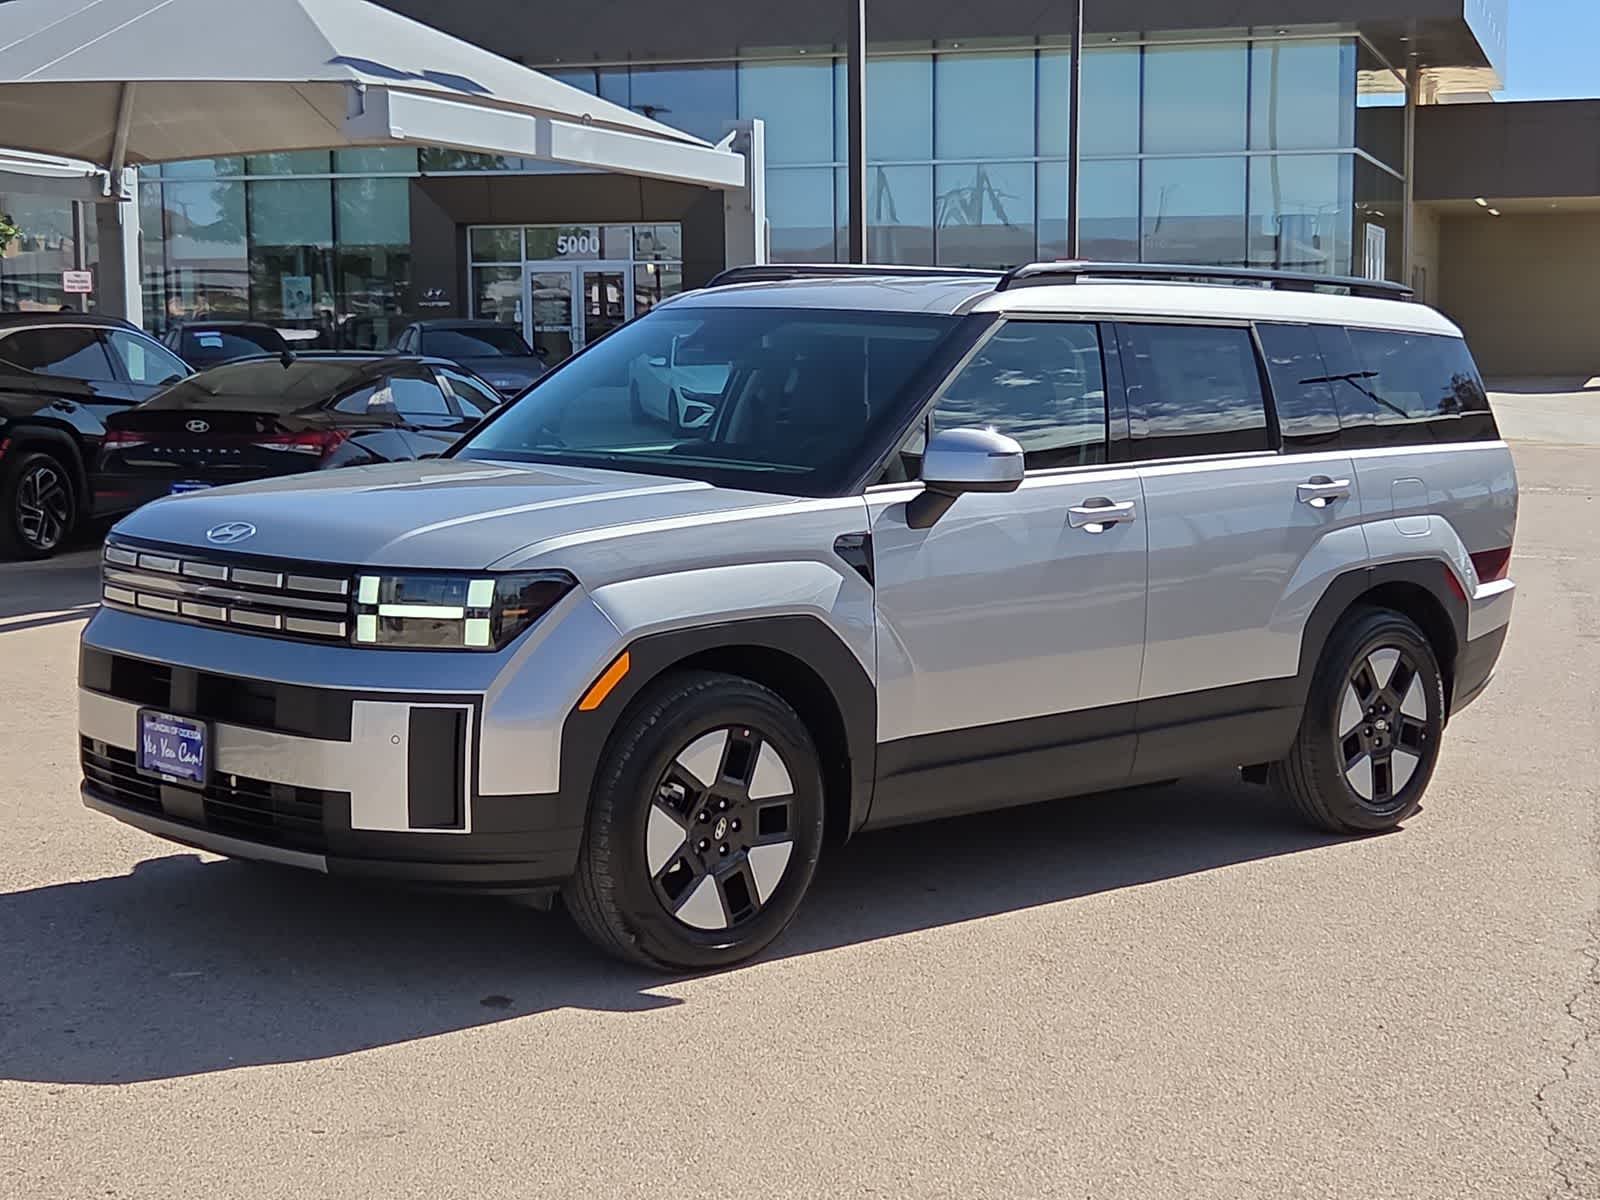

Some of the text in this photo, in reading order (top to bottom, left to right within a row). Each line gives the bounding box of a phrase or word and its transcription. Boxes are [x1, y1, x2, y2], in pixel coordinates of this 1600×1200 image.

[557, 235, 600, 254] 5000
[144, 734, 204, 766] Yes You Can!
